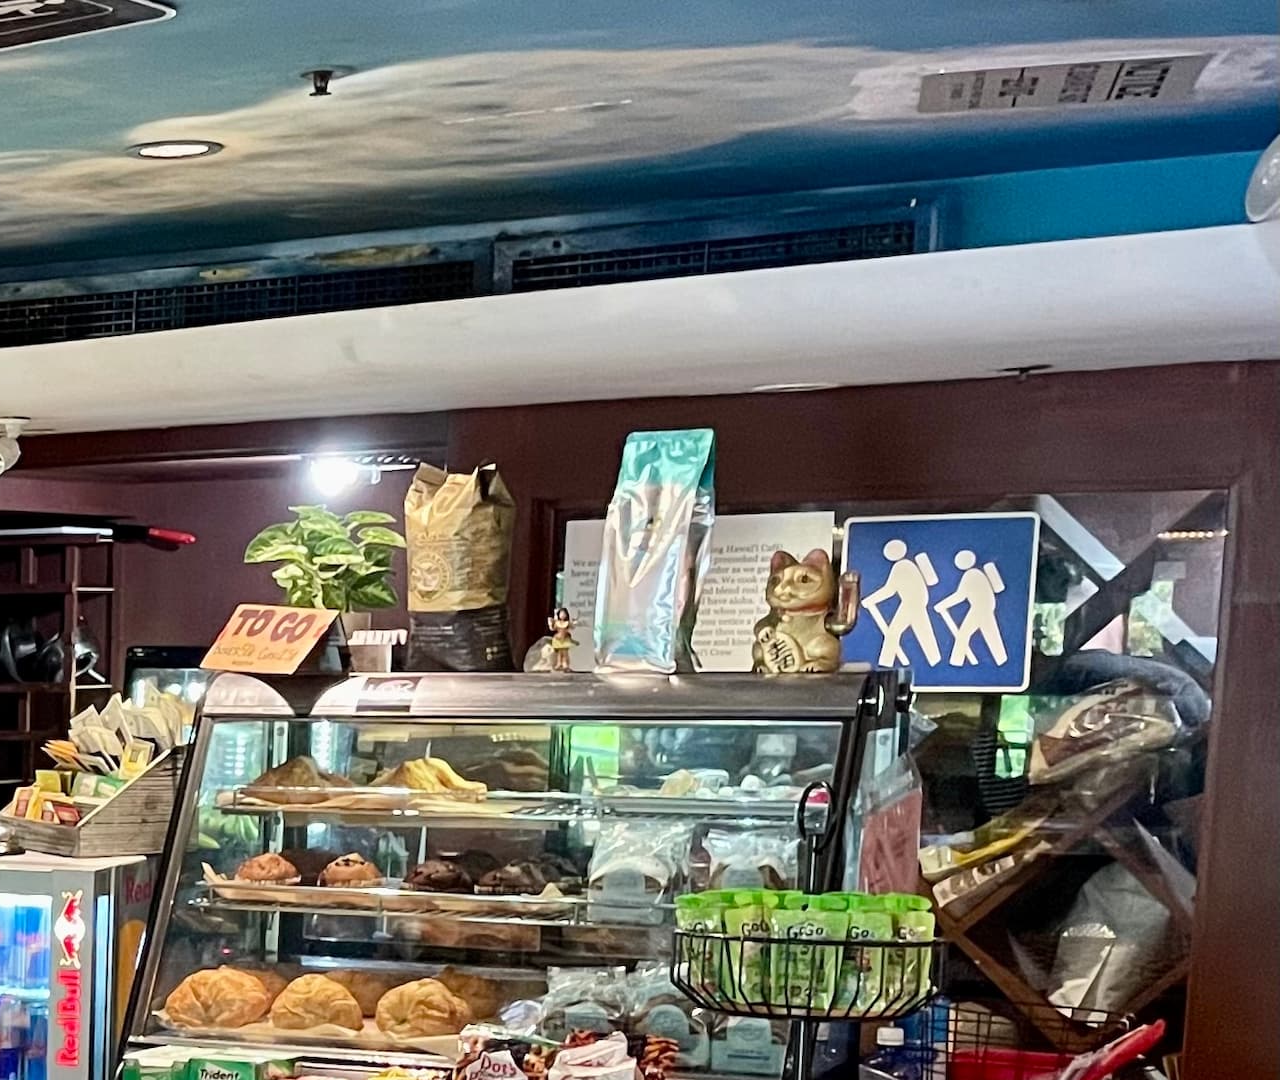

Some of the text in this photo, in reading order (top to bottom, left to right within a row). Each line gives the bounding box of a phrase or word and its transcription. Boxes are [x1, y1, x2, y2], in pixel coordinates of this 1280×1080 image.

[233, 609, 316, 643] TO GO
[199, 1069, 240, 1080] Trident
